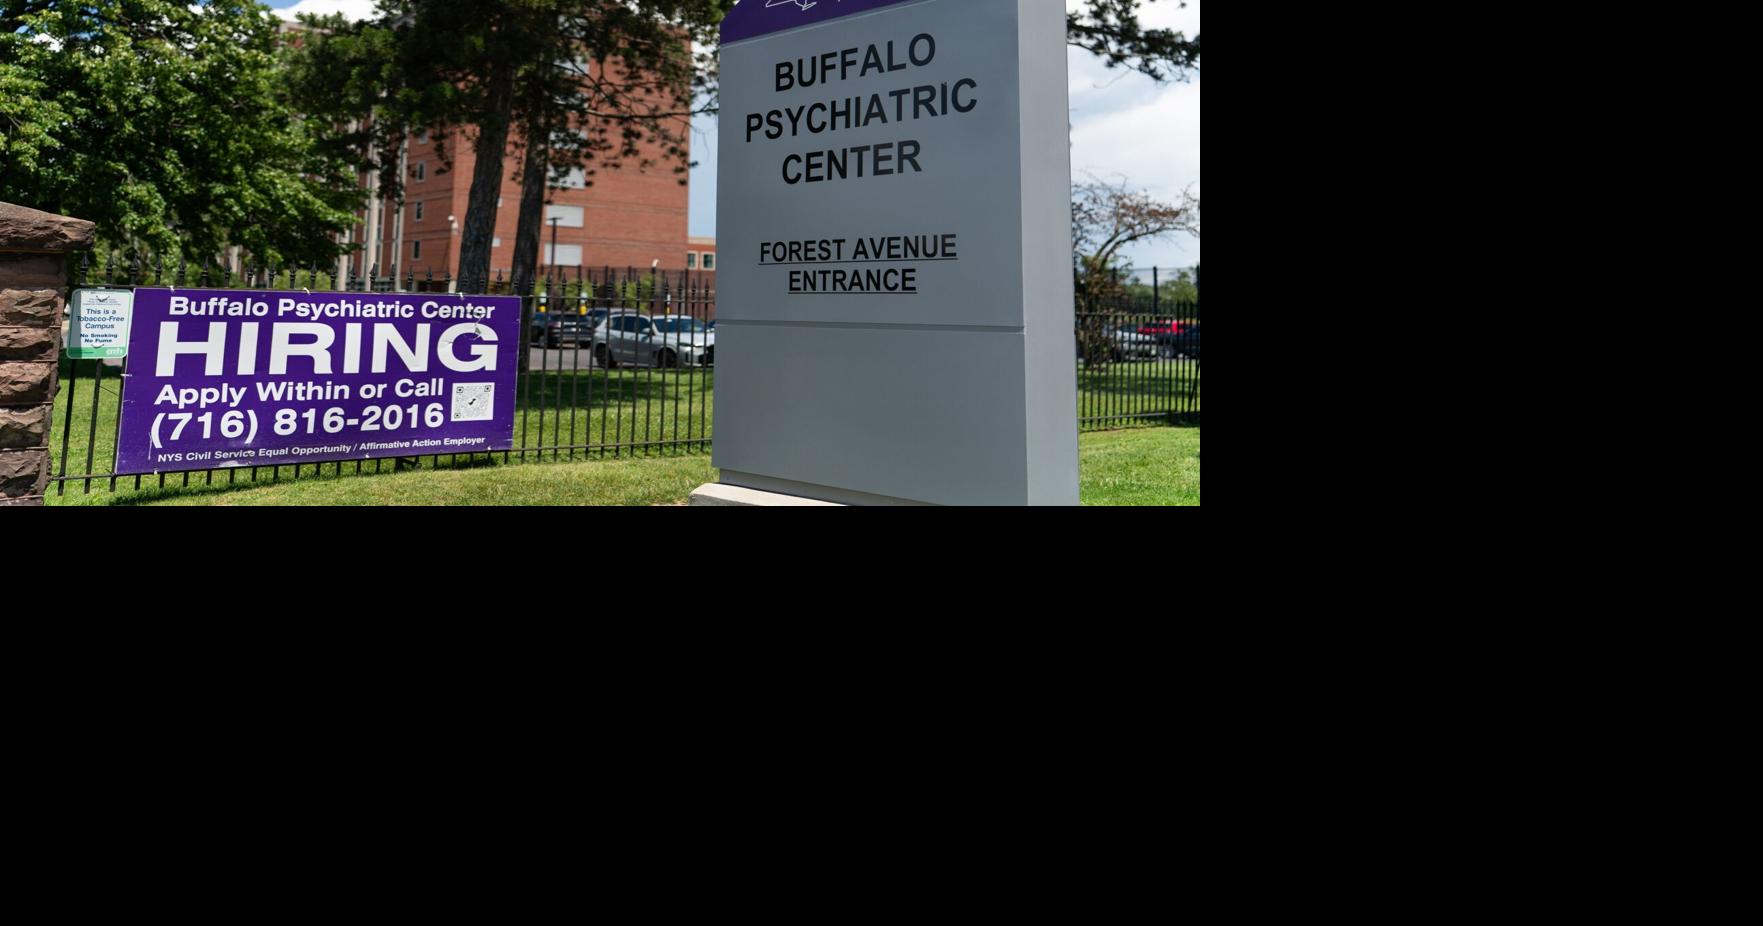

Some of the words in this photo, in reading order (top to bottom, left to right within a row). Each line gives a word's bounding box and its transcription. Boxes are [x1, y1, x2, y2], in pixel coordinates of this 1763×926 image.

[775, 33, 936, 92] BUFFALO
[746, 78, 978, 142] PSYCHIATRIC
[782, 140, 922, 185] CENTER
[760, 238, 846, 263] FOREST
[852, 233, 957, 259] AVENUE
[788, 268, 917, 292] ENTRANCE
[169, 296, 269, 317] Buffalo
[278, 298, 415, 321] Psychiatric
[421, 300, 496, 319] Center
[85, 322, 115, 330] Campus
[155, 321, 499, 377] HIRING
[154, 382, 247, 409] Apply
[256, 380, 350, 402] Within
[359, 383, 388, 399] or
[395, 378, 444, 398] Call
[150, 409, 259, 449] (716)
[273, 402, 445, 436] 816-2016
[157, 453, 183, 463] NYS
[186, 451, 211, 461] Civil
[214, 450, 256, 460] Service
[258, 447, 288, 458] Equal
[291, 444, 351, 456] Opportunity
[359, 440, 410, 451] Affirmative
[412, 438, 441, 448] Action
[444, 436, 486, 446] Employer
